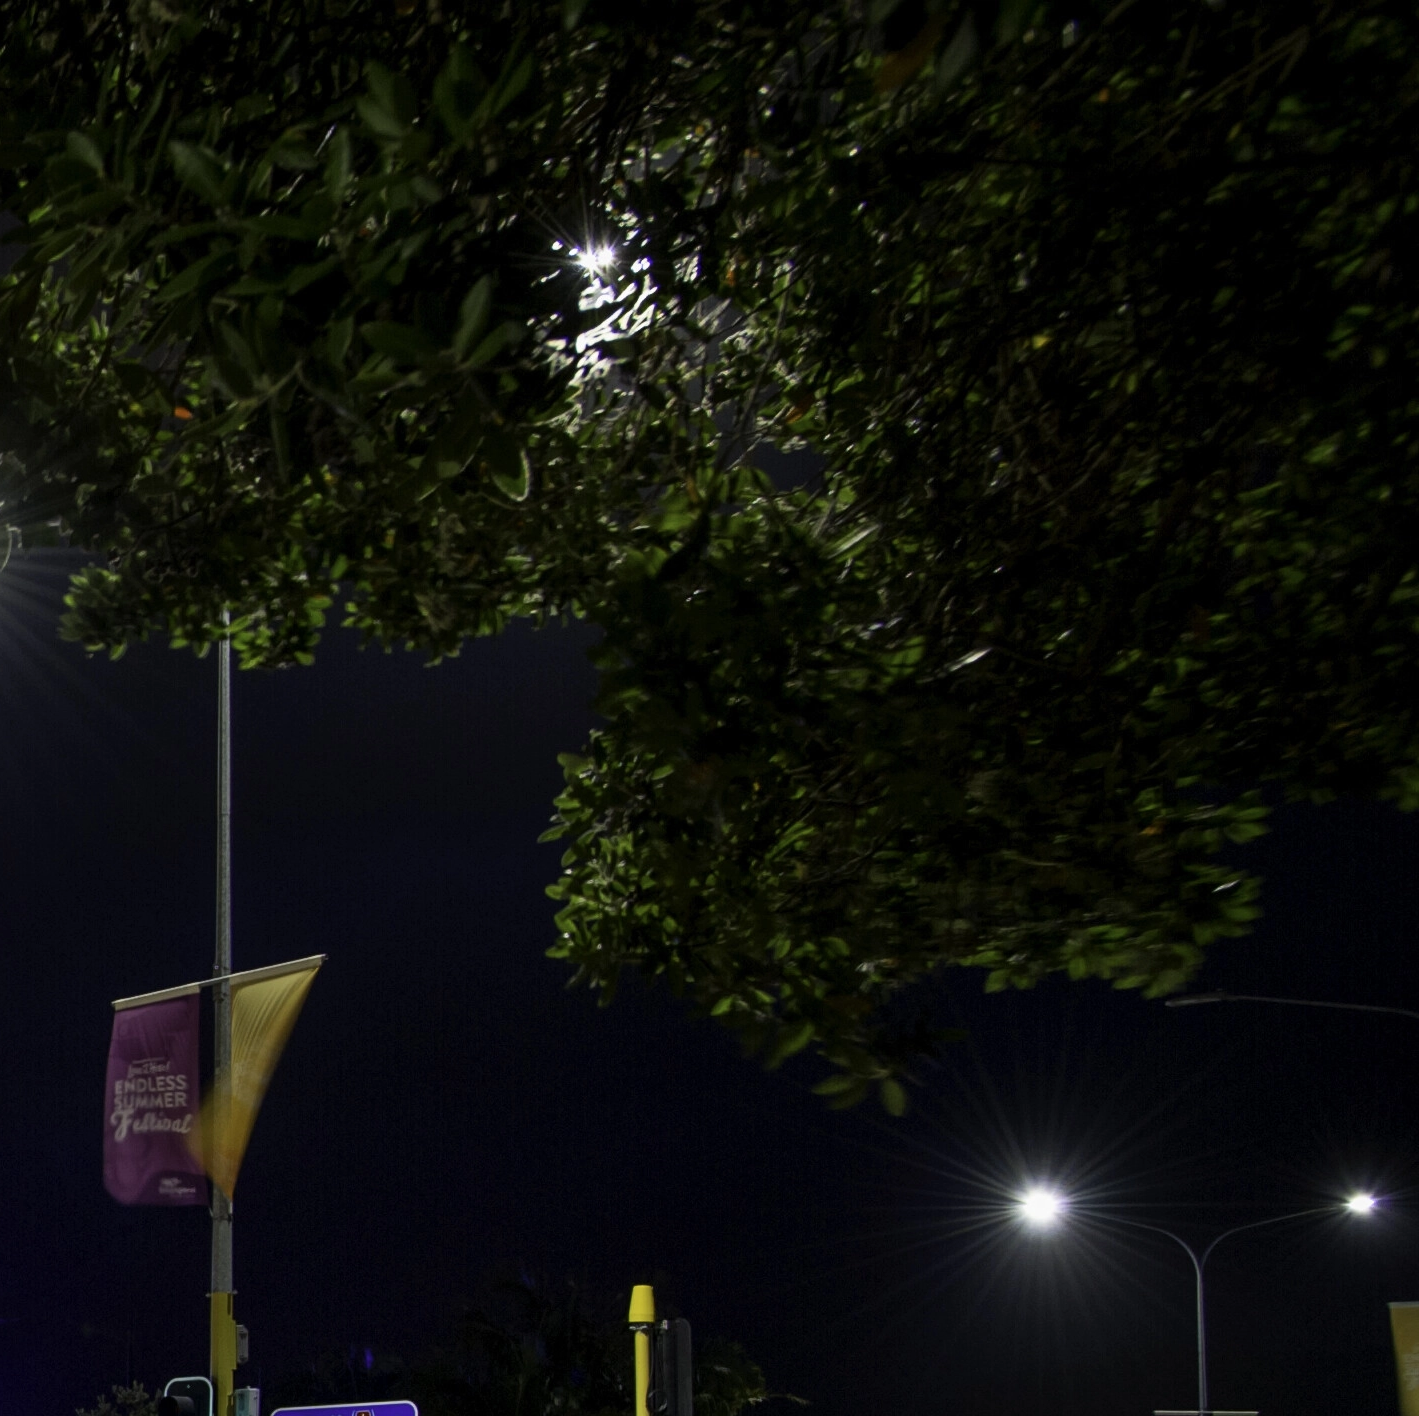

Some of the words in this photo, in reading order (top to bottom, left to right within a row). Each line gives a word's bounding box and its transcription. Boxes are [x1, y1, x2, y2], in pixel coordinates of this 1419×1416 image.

[114, 1074, 188, 1095] ENDLESS
[114, 1091, 188, 1111] SUMMER
[110, 1108, 192, 1143] Festival
